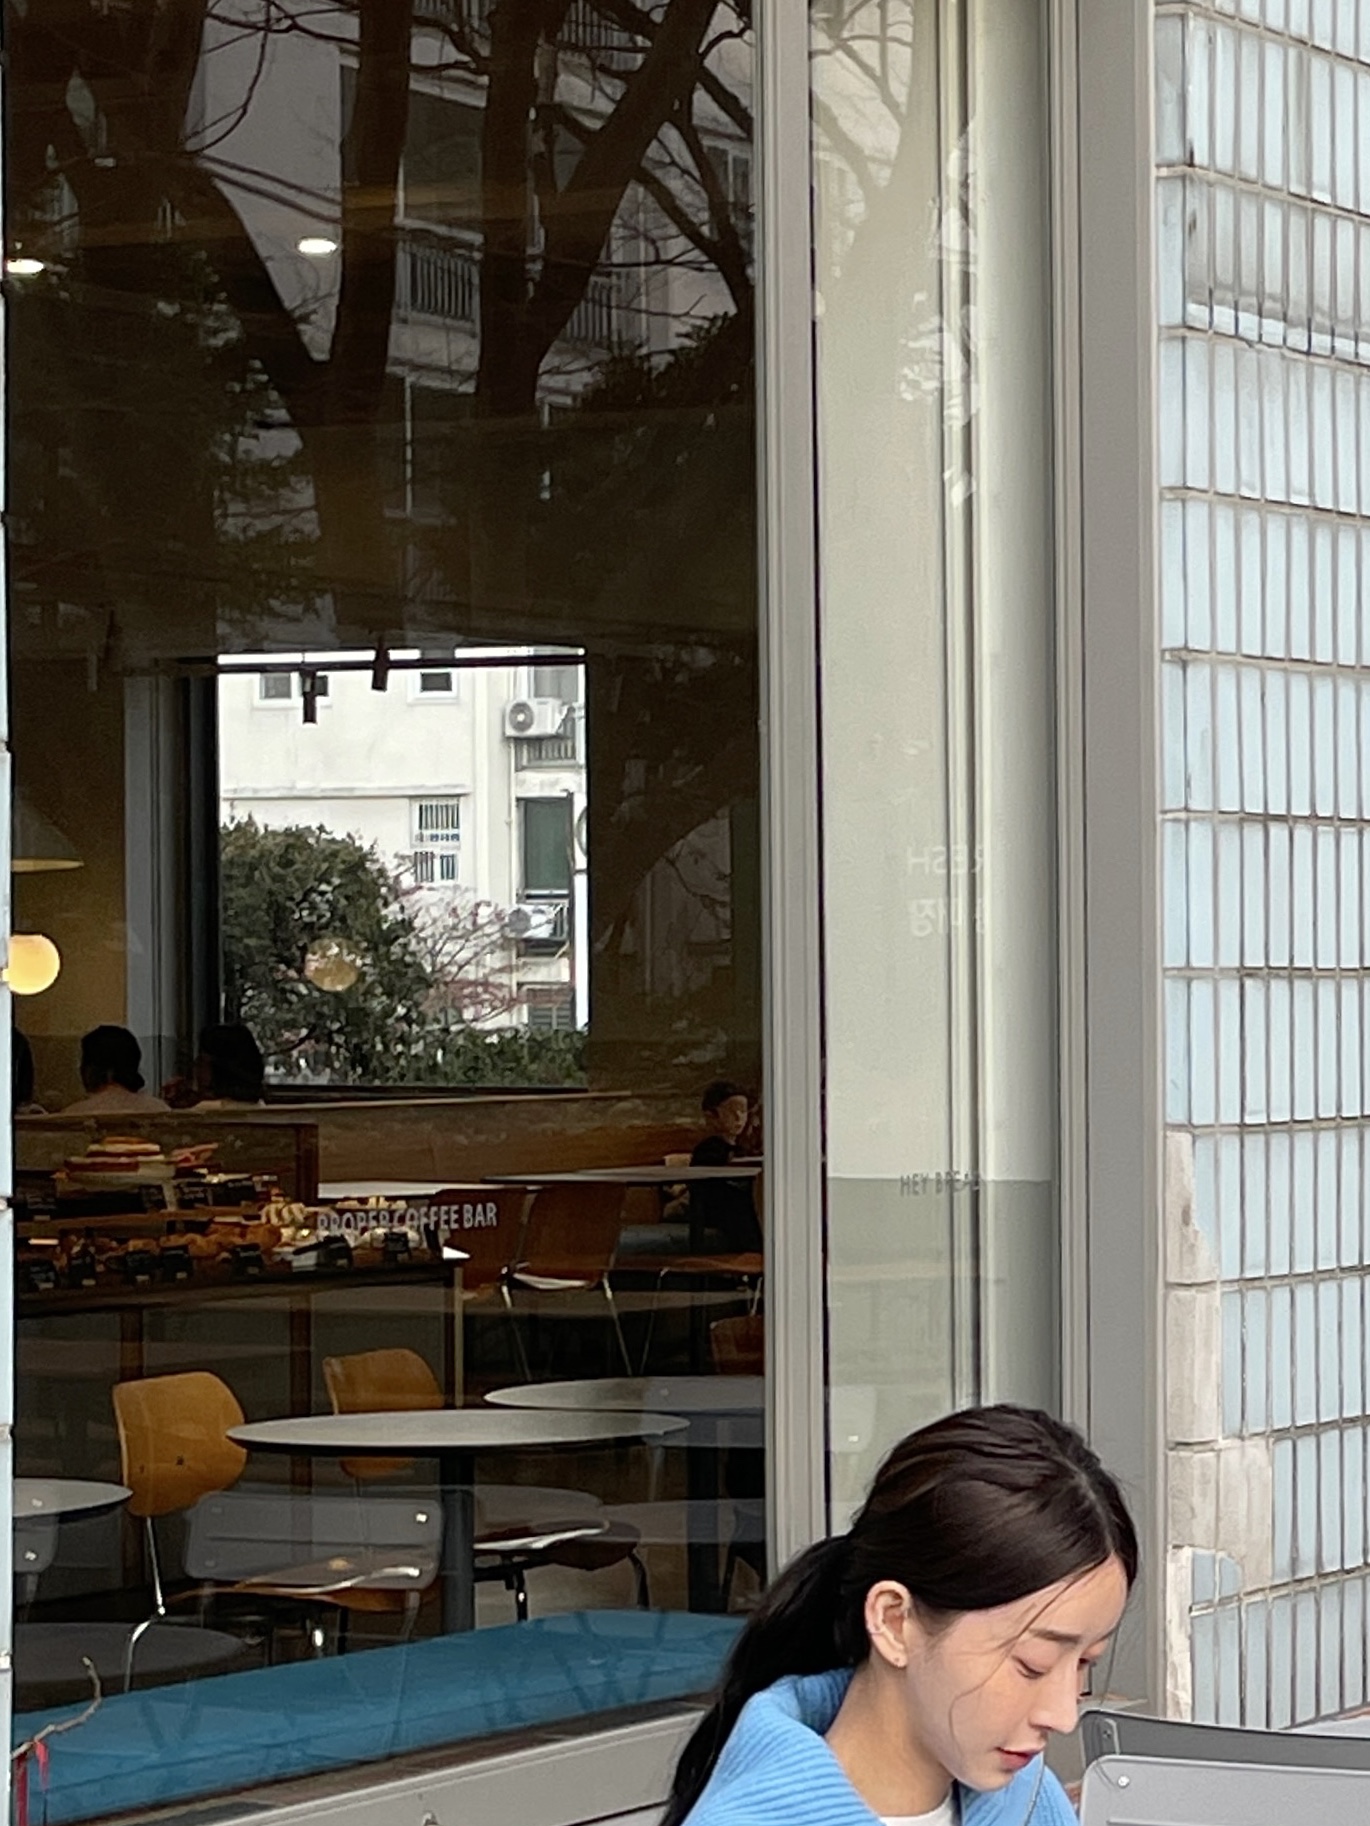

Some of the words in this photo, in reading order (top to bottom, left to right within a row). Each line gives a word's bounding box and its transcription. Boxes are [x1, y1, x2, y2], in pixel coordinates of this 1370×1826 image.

[900, 1173, 929, 1197] HEY
[317, 1210, 390, 1236] PROPER
[393, 1204, 460, 1233] COFFEE
[463, 1202, 497, 1229] BAR
